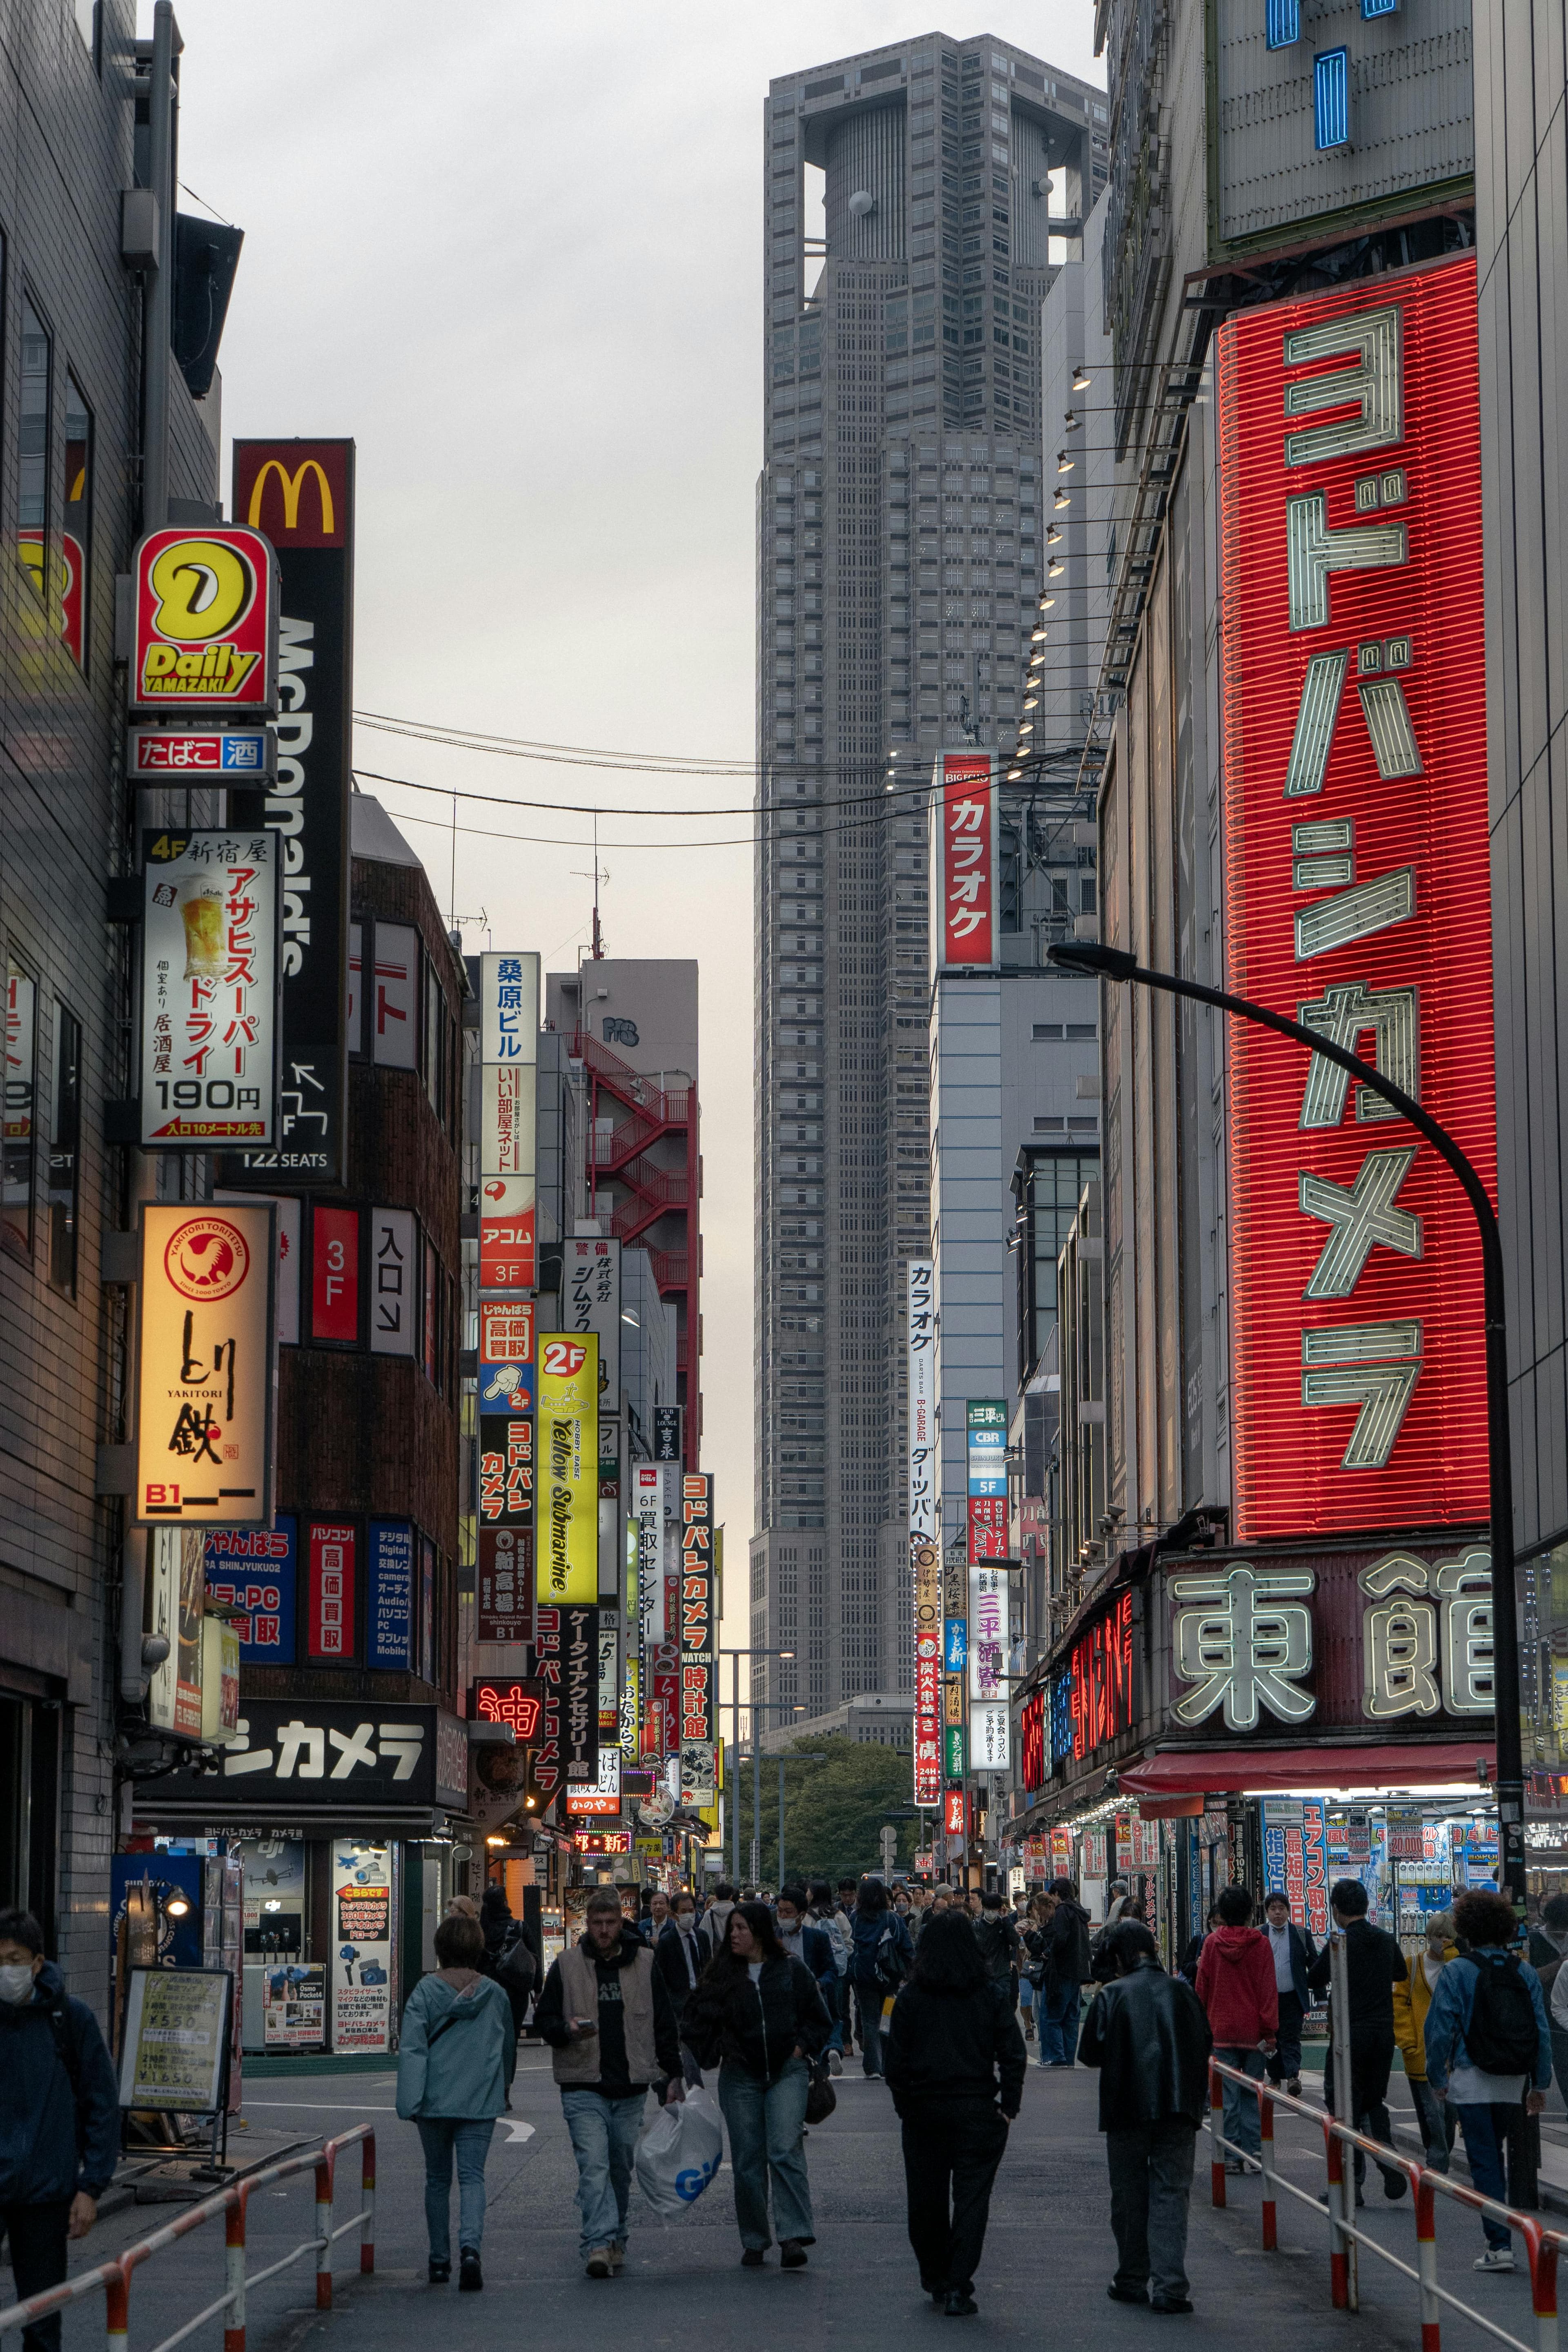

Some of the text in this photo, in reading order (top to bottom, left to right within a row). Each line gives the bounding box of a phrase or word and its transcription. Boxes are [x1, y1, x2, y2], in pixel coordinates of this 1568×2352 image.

[145, 644, 260, 692] Daily
[145, 677, 225, 693] YAMAZAKI
[142, 740, 260, 766] たばこ 酒
[945, 774, 962, 783] BIG
[151, 835, 186, 859] 4F
[187, 840, 268, 864] 新宿屋
[949, 800, 987, 938] カラオケ
[1282, 304, 1425, 1470] ヨドバシカメラ
[224, 867, 259, 1078] アサヒスーパー
[153, 960, 173, 1074] 個室あり 居酒屋
[497, 959, 523, 1058] 桑原ビル
[183, 978, 216, 1078] ドライ
[156, 1080, 261, 1111] 190円
[167, 1122, 261, 1137] 入口10メートル先
[497, 1068, 512, 1172] いい部屋ネット
[281, 1154, 327, 1167] SEATS
[171, 1223, 243, 1257] YAKITORI TORITETSU
[483, 1228, 532, 1244] アコム
[576, 1242, 608, 1256] 警備
[377, 1227, 405, 1296] 入口
[496, 1266, 519, 1281] 3F
[180, 1281, 194, 1293] SINCE
[212, 1281, 231, 1294] TOKYO
[596, 1257, 612, 1303] 株式会社
[483, 1304, 532, 1315] じゃんぱら
[910, 1267, 933, 1352] カラオケ
[490, 1320, 526, 1338] 高価
[490, 1339, 526, 1357] 買取
[544, 1341, 587, 1375] 2F
[168, 1390, 222, 1399] YAKITORI
[511, 1394, 529, 1407] 2F
[917, 1399, 926, 1442] B-GARAGE
[660, 1428, 675, 1460] 吉永
[976, 1432, 1000, 1443] CBR
[507, 1421, 532, 1512] ヨドバシ
[146, 1484, 180, 1503] B1
[481, 1452, 505, 1520] カメラ
[911, 1447, 934, 1528] ダーツバー
[980, 1481, 996, 1493] 5F
[550, 1418, 575, 1593] Yellow Submarine
[640, 1495, 657, 1507] 6F
[995, 1500, 1003, 1527] 西安料理
[312, 1528, 354, 1542] パソコン!
[379, 1544, 406, 1555] Digital
[219, 1561, 281, 1573] SHINJYUKU02
[640, 1511, 657, 1635] 買取センター
[682, 1475, 708, 1650] ヨドバシカメラ
[990, 1570, 998, 1593] お食事と
[321, 1545, 343, 1653] 高価買取
[377, 1621, 389, 1630] PC
[376, 1646, 406, 1655] Mobile
[568, 1610, 589, 1777] ケータイアクセサリー館
[683, 1666, 708, 1740] 時計館
[920, 1662, 935, 1733] 炭火串焼き
[984, 1690, 996, 1698] 3F
[479, 1686, 539, 1737] 油
[620, 1685, 635, 1760] おたからや
[985, 1710, 995, 1763] ご予約承ります
[997, 1709, 1006, 1760] ご宴会・コンパ
[920, 1776, 937, 1784] 営業
[571, 1799, 607, 1811] かのや
[205, 1827, 262, 1837] ヨドバシカメラ
[1031, 1843, 1044, 1854] 13
[1052, 1839, 1067, 1851] 13
[1032, 1865, 1045, 1875] 10
[1054, 1863, 1068, 1875] 10
[1267, 1829, 1286, 1894] 指定日
[1304, 1806, 1327, 1934] エアコン取付
[1286, 1829, 1305, 1928] 最短翌日
[345, 1888, 384, 1897] こちらです
[341, 1901, 387, 1911] ウェアラブルカメラ
[341, 1911, 386, 1920] 360度カメラ
[343, 1920, 385, 1929] ビデオカメラ
[350, 1930, 379, 1939] ドローン
